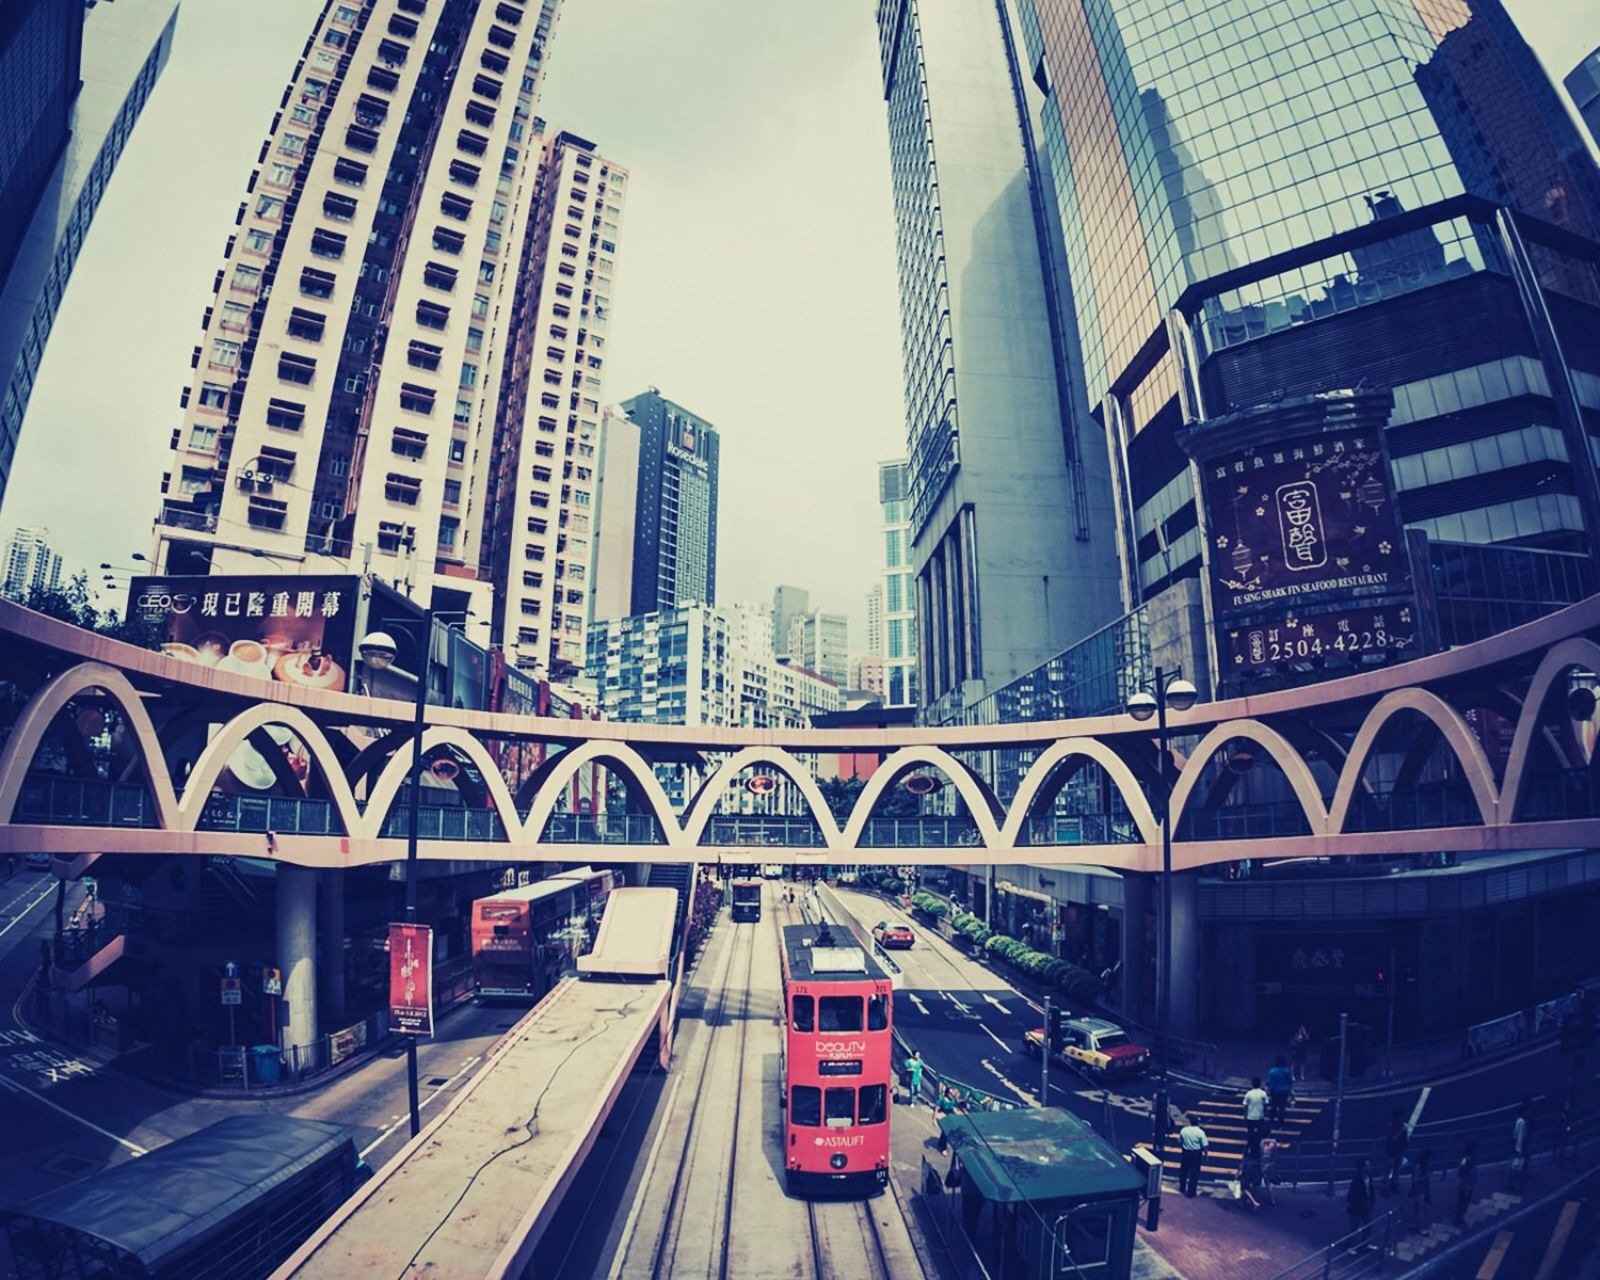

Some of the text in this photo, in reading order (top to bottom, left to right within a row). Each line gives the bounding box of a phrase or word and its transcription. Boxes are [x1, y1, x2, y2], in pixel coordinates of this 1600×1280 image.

[1243, 590, 1262, 604] SING
[1262, 587, 1287, 600] SHARK
[1288, 583, 1302, 596] FIN
[1302, 580, 1338, 593] SEAFOOD
[1339, 573, 1389, 588] RESTAURANT
[137, 595, 172, 608] CEO
[201, 591, 342, 618] 現已隆重開幕
[824, 1135, 865, 1147] ASTALIFT
